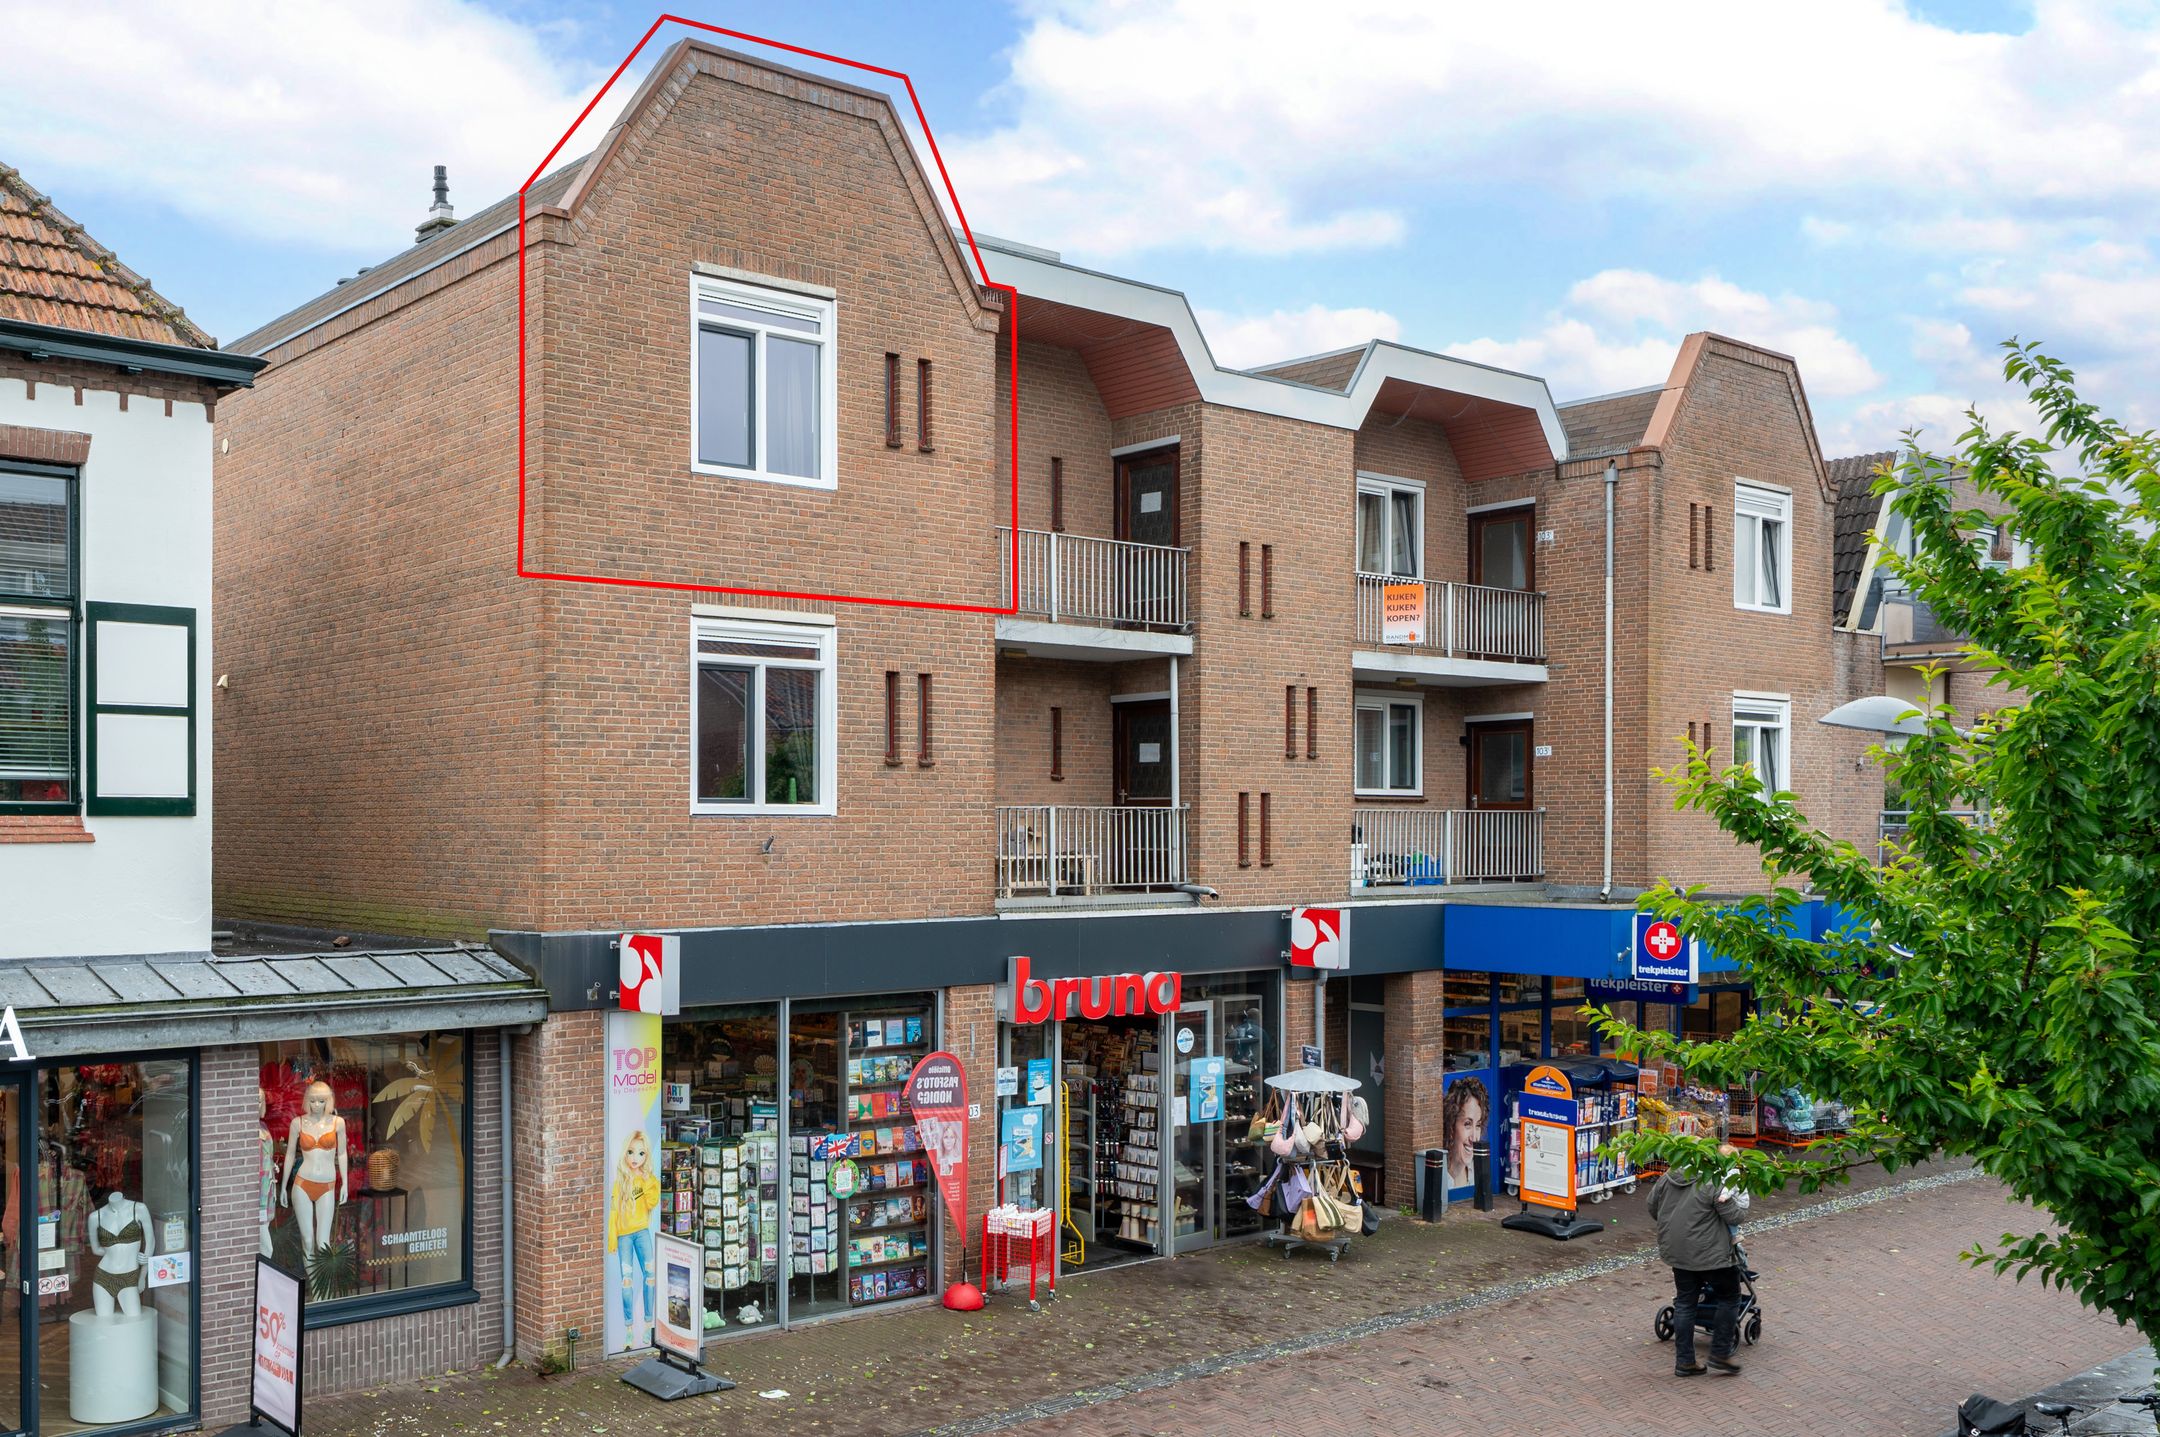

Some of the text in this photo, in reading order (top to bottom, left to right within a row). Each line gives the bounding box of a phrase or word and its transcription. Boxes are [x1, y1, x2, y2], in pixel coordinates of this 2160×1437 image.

[1387, 593, 1416, 601] KIJKEN
[1387, 603, 1416, 611] KIJKEN
[1386, 614, 1420, 622] KOPEN?
[1638, 966, 1689, 977] trekpleister
[1009, 956, 1182, 1024] bruna
[1590, 978, 1669, 993] trekpleister
[613, 1047, 658, 1071] TOP
[613, 1069, 657, 1087] Model
[666, 1085, 683, 1096] ART
[381, 1227, 448, 1246] SCHAAMTELOOS
[409, 1238, 447, 1253] GENIETEN
